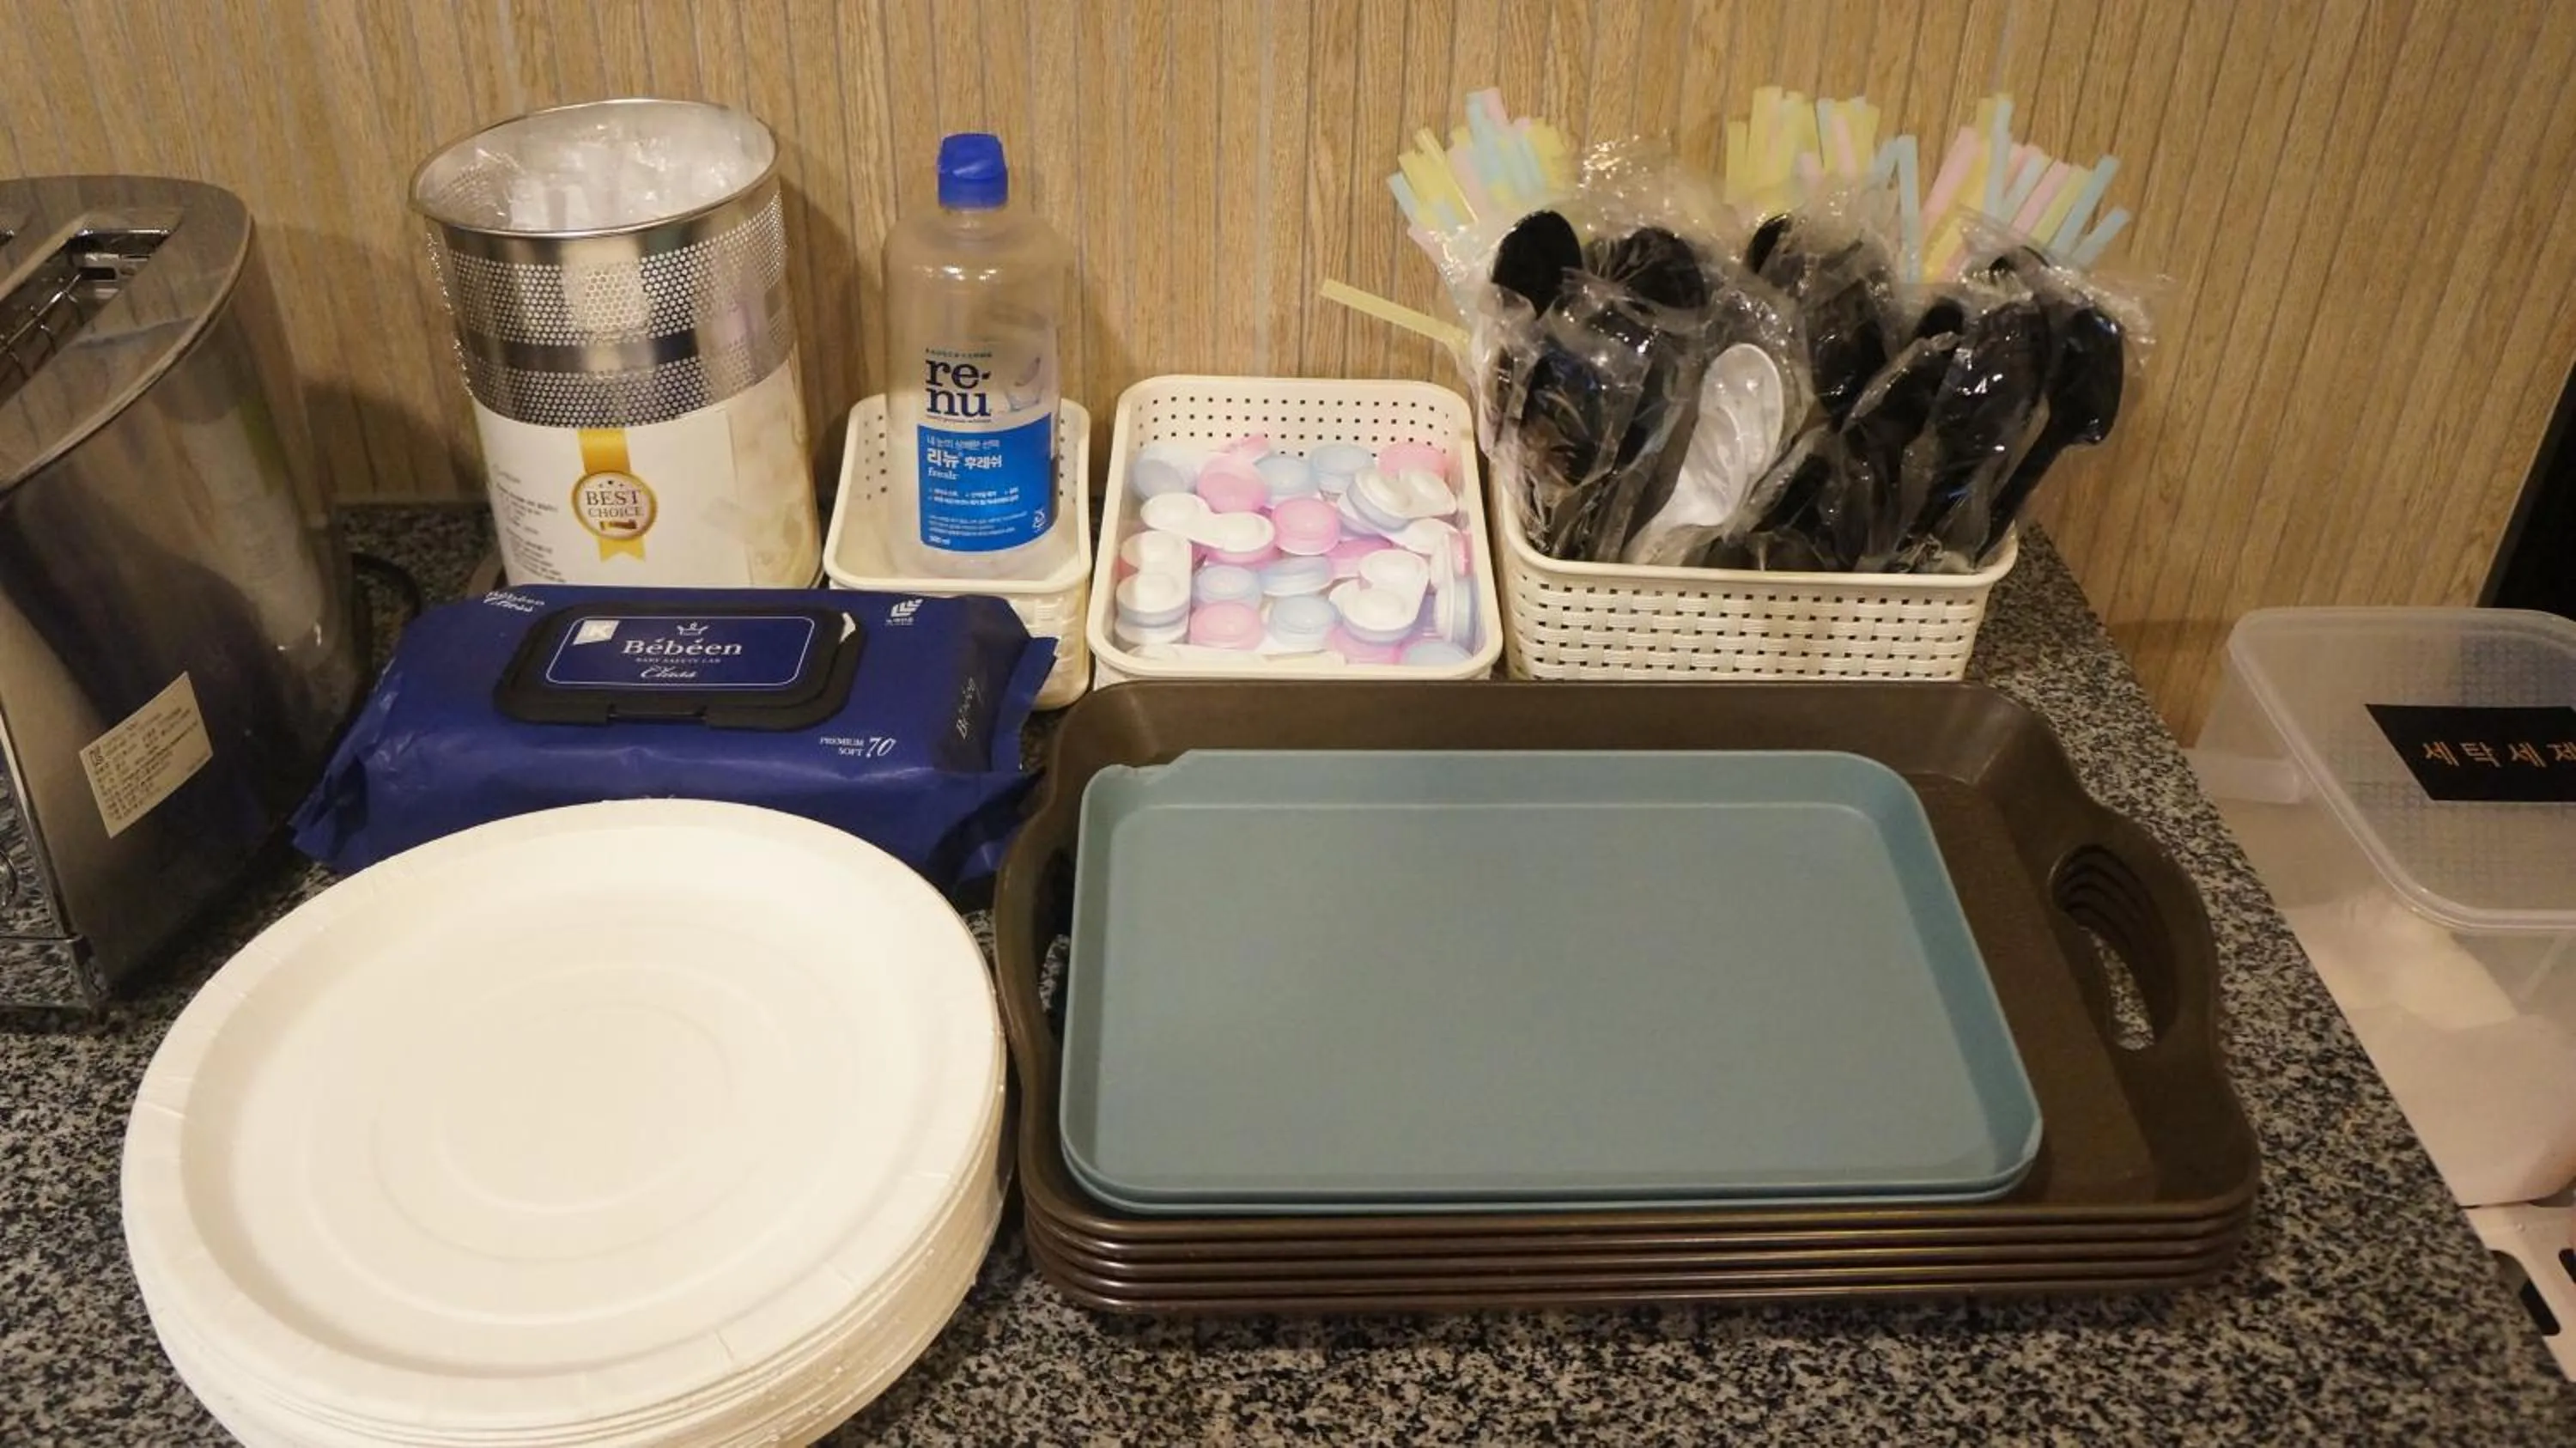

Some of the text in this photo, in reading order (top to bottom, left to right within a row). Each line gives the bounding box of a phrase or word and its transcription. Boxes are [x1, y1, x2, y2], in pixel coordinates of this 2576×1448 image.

[925, 388, 992, 417] nu
[927, 447, 1003, 470] 리뉴 후레쉬
[586, 490, 641, 506] BEST
[588, 506, 642, 518] CHOICE
[622, 637, 743, 655] Bébéen
[838, 747, 864, 757] SOFT
[866, 737, 896, 757] 70
